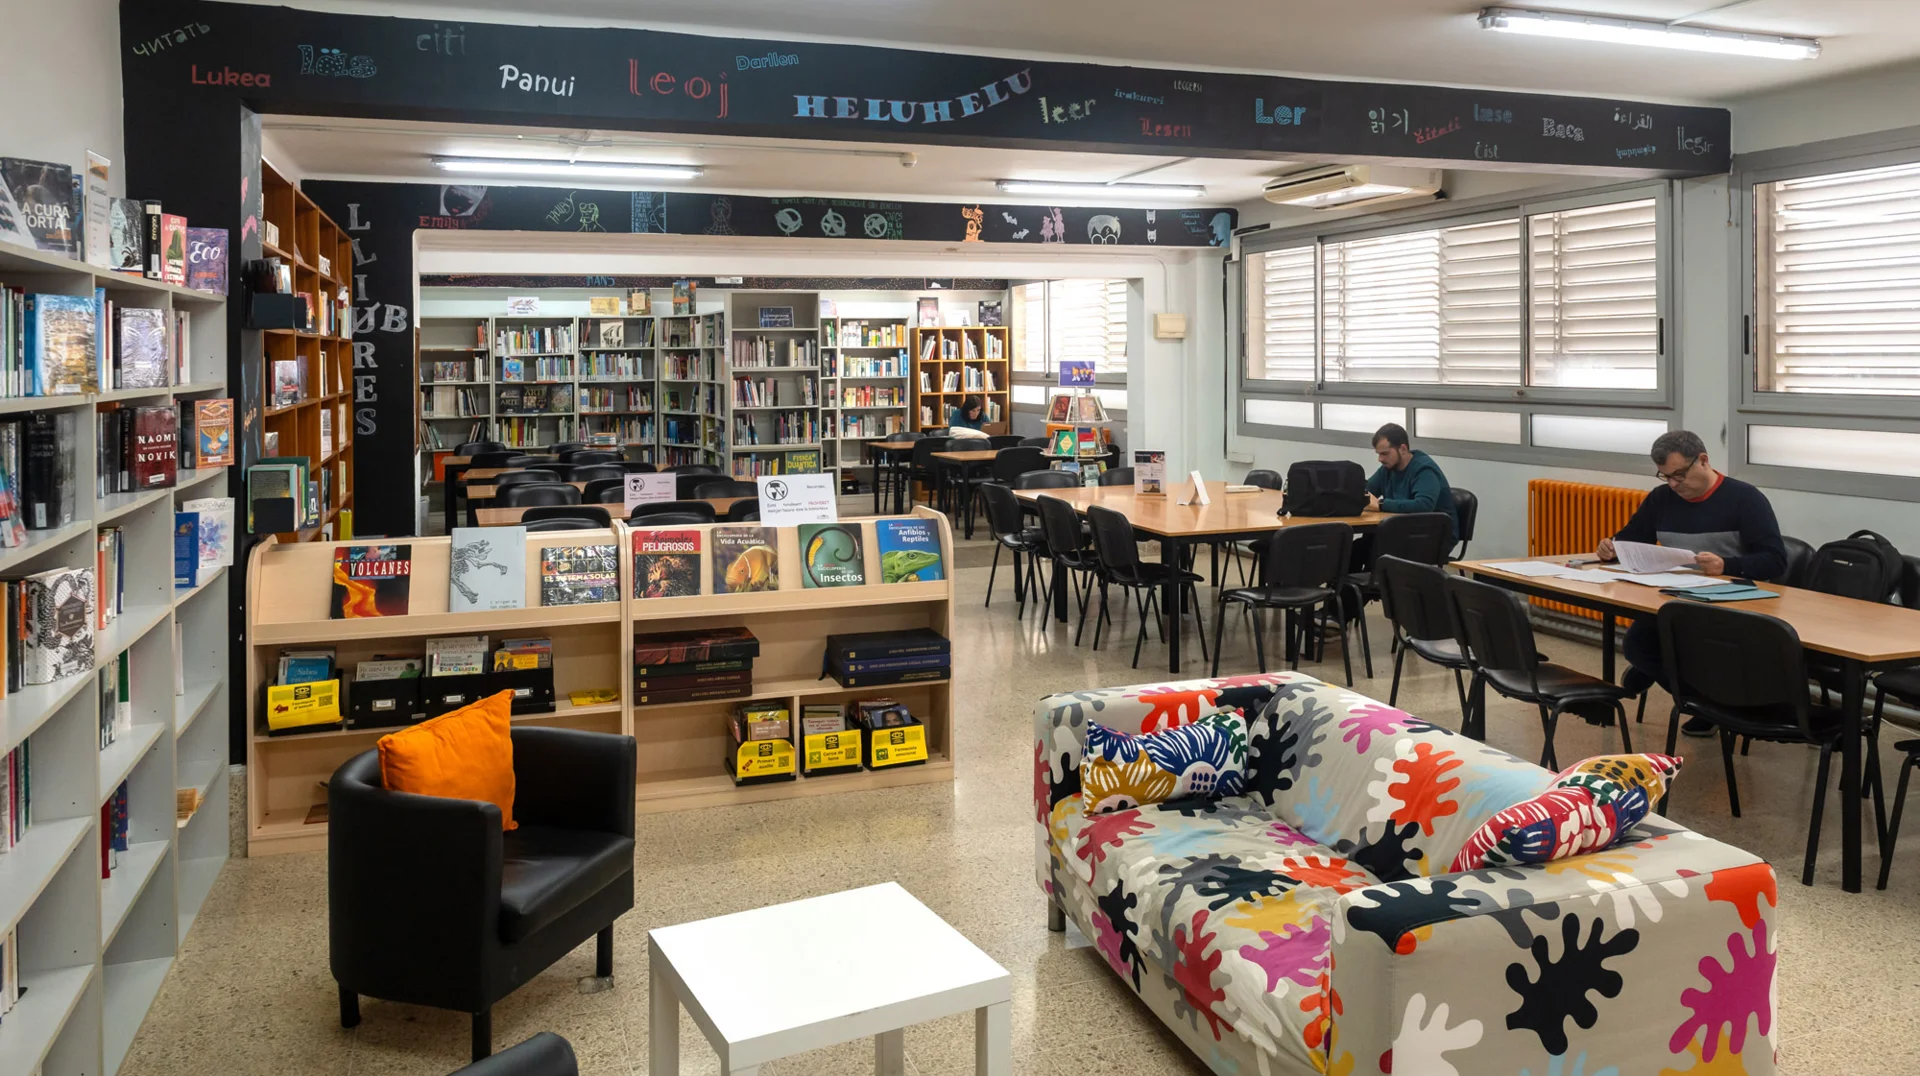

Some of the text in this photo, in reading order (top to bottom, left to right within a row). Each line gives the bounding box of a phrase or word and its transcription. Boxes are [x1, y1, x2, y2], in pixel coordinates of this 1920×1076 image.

[132, 22, 211, 58] читать
[735, 51, 799, 71] Darllen
[191, 64, 271, 87] Lukea
[499, 64, 575, 97] Panui
[793, 68, 1032, 124] HELUHELU
[1038, 97, 1096, 124] leer
[1255, 98, 1306, 126] Ler
[1614, 107, 1653, 130] القراءة
[1140, 118, 1191, 137] Lesen
[35, 204, 70, 221] CURA
[190, 241, 222, 264] Eco
[138, 433, 176, 445] NAOMI
[138, 451, 176, 462] NOVIK
[642, 541, 695, 552] PELIGROSOS
[902, 535, 929, 543] Reptiles
[350, 560, 410, 576] VOLCANES
[555, 574, 588, 582] SISTEMA
[589, 572, 617, 580] SOLAR
[820, 573, 863, 583] Insectos
